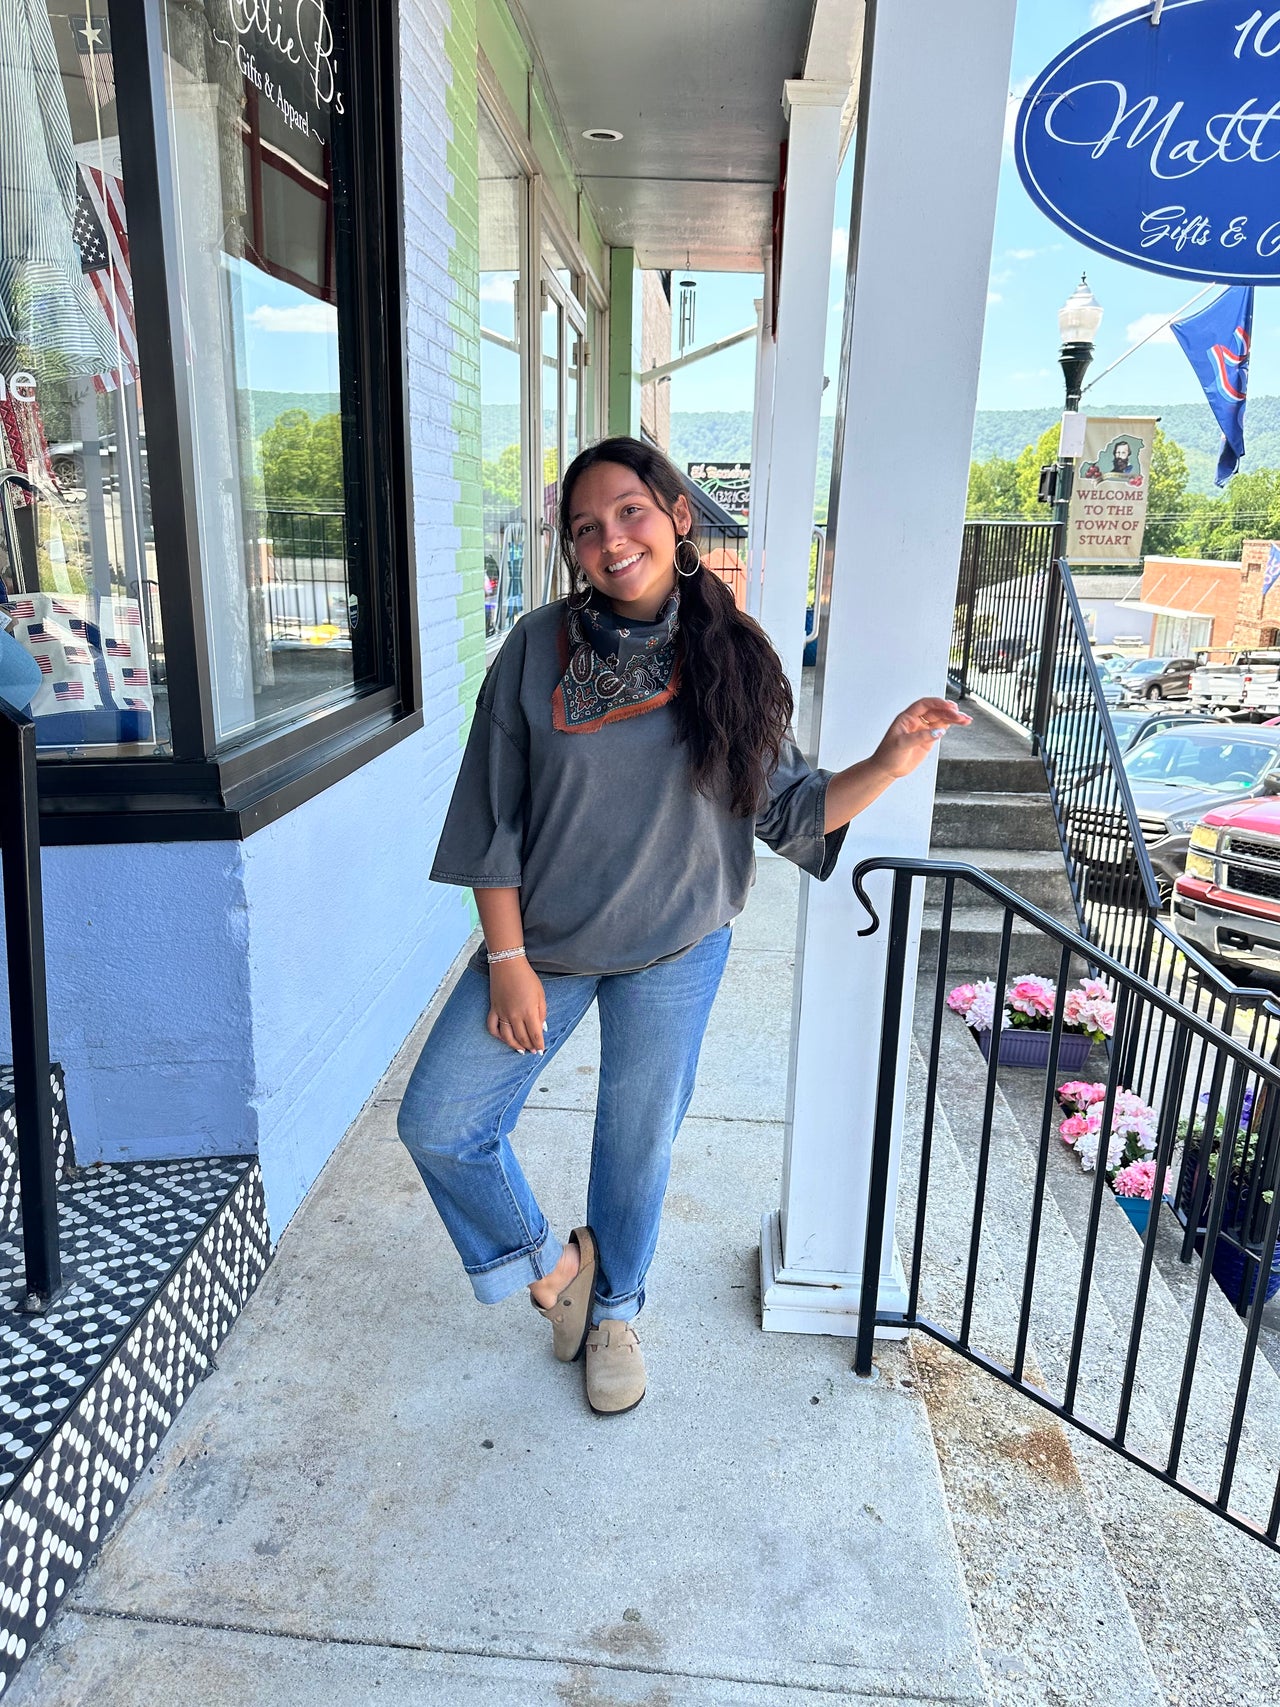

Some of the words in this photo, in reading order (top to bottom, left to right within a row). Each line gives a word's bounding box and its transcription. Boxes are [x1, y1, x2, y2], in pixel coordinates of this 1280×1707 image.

[237, 44, 263, 90] Gifts
[264, 72, 275, 103] &
[276, 84, 310, 138] Apparel
[1139, 205, 1212, 252] Gifts
[1219, 215, 1247, 248] &
[1076, 490, 1144, 501] WELCOME
[1084, 505, 1104, 516] TO
[1106, 505, 1134, 516] THE
[1075, 520, 1119, 531] TOWN
[1122, 520, 1140, 531] OF
[1078, 535, 1132, 546] STUART
